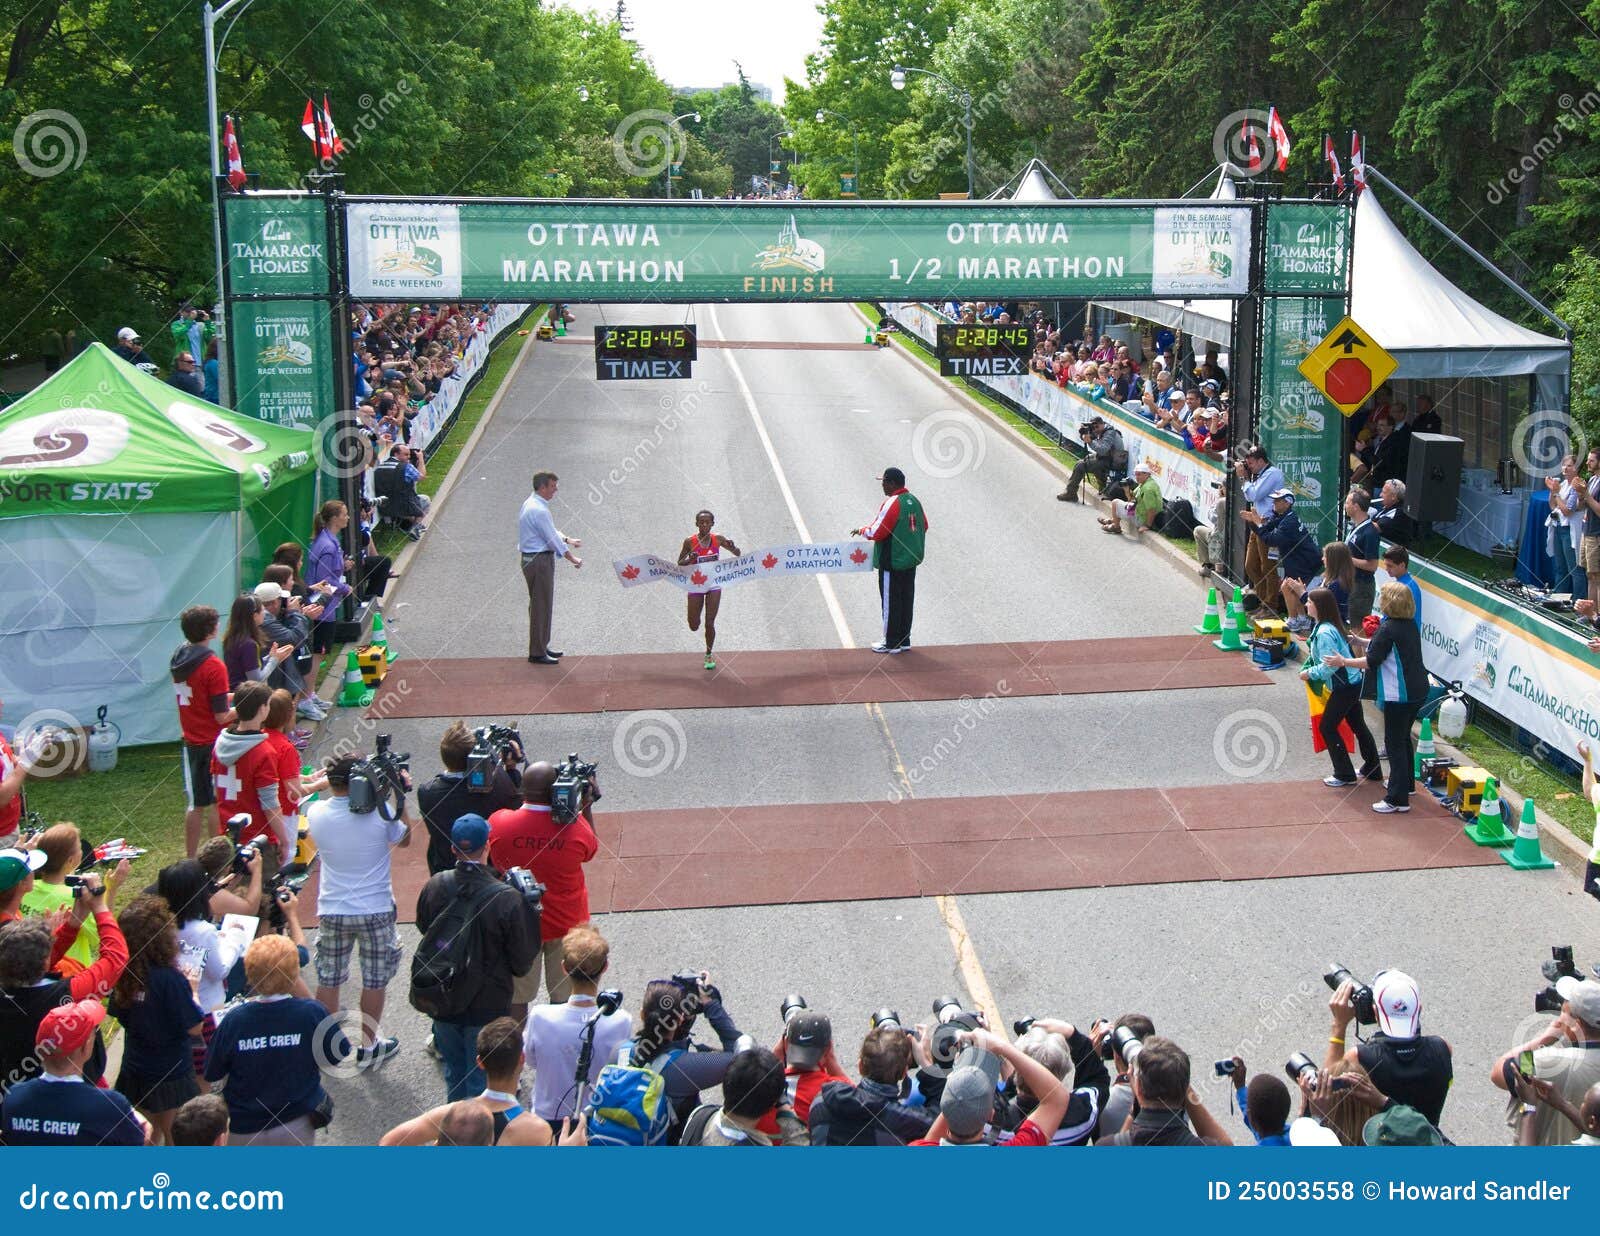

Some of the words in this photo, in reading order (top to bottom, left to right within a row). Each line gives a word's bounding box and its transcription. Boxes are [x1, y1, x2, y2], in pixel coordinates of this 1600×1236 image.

[527, 223, 660, 247] OTTAWA
[946, 222, 1070, 245] OTTAWA
[232, 242, 322, 258] TAMARACK
[249, 258, 308, 275] HOMES
[503, 259, 685, 283] MARATHON
[888, 257, 942, 285] 1/2
[958, 256, 1125, 280] MARATHON
[1283, 259, 1332, 274] HOMES
[400, 280, 443, 288] WEEKEND
[744, 276, 834, 293] FINISH
[605, 359, 683, 379] TIMEX
[949, 357, 1021, 375] TIMEX
[786, 547, 841, 558] OTTAWA
[715, 556, 754, 573] OTTAWA
[785, 558, 842, 569] MARATHON
[512, 836, 566, 850] CREW
[238, 1035, 267, 1050] RACE
[269, 1033, 301, 1048] CREW
[12, 1118, 40, 1134] RACE
[43, 1120, 81, 1136] CREW
